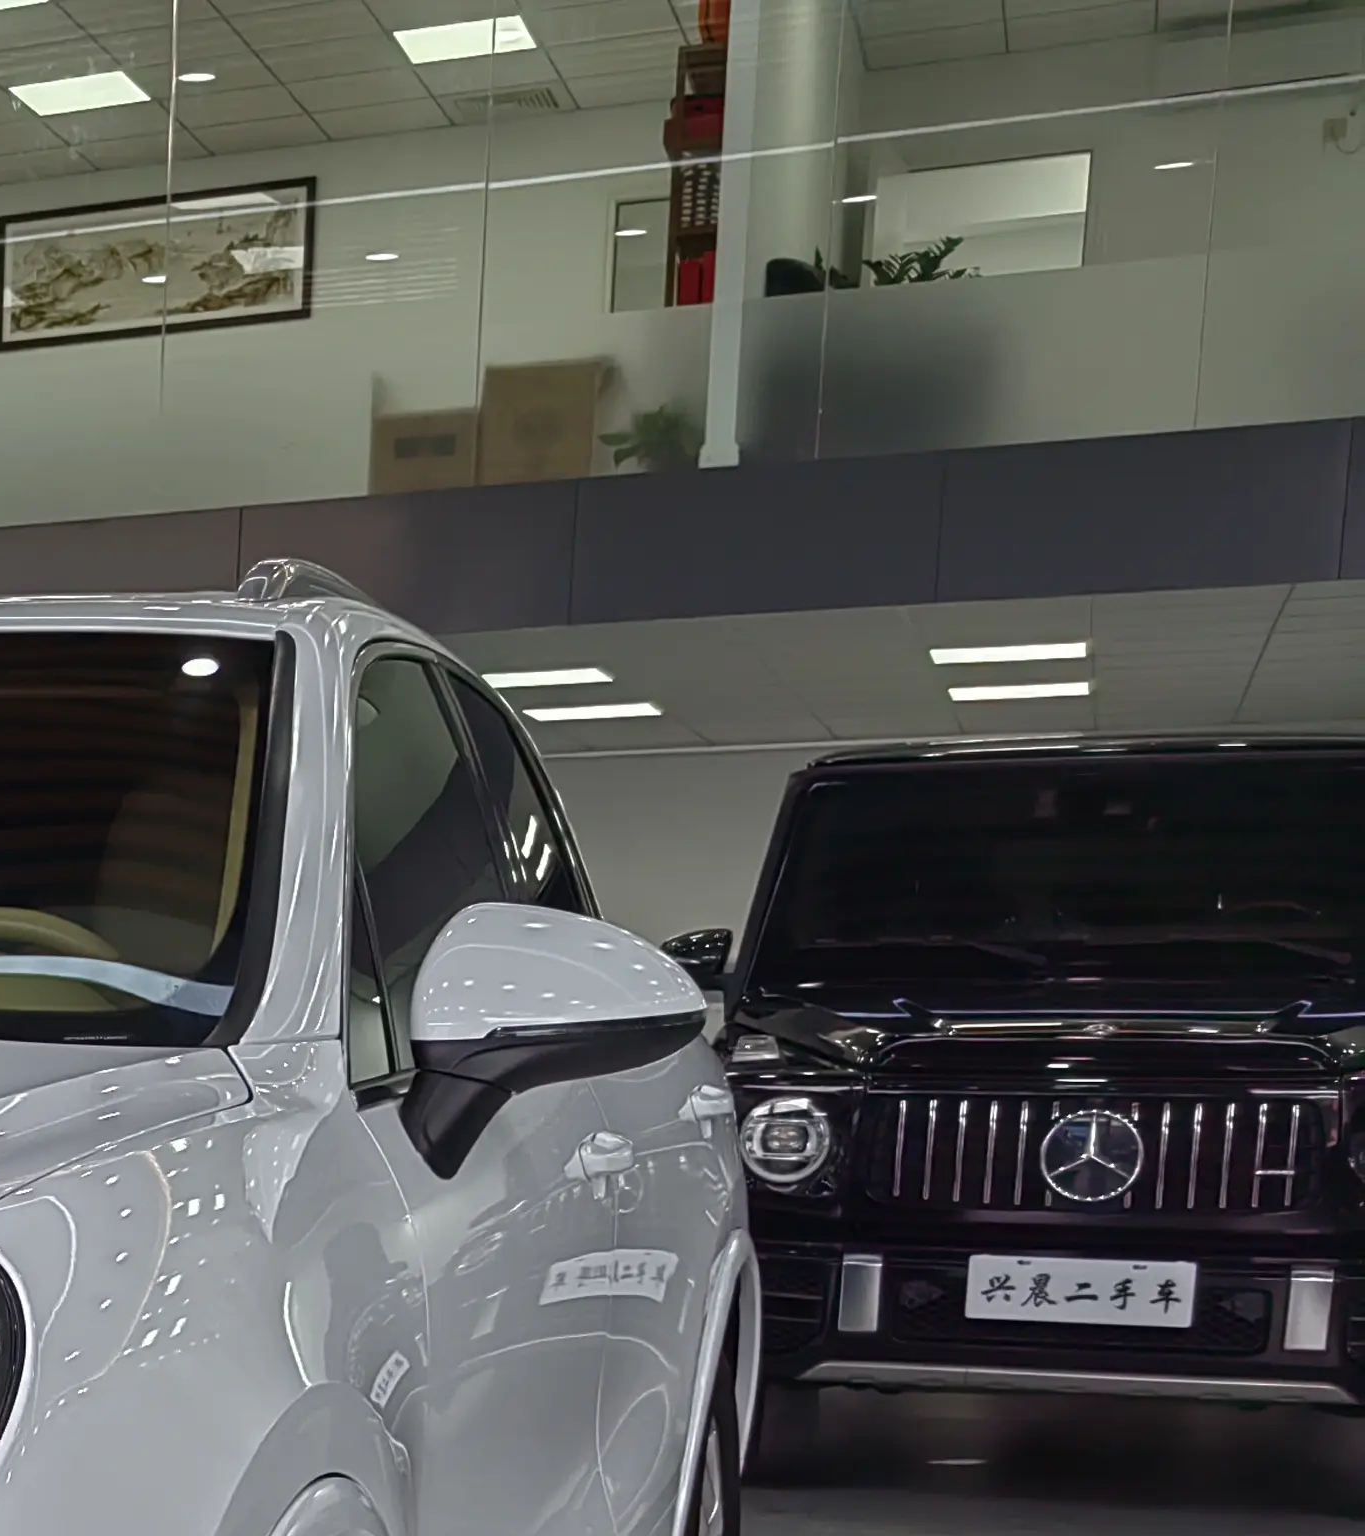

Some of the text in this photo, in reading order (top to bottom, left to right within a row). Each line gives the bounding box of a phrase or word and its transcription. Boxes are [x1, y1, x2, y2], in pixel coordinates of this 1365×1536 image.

[981, 1273, 1182, 1313] 兴晨二手车
